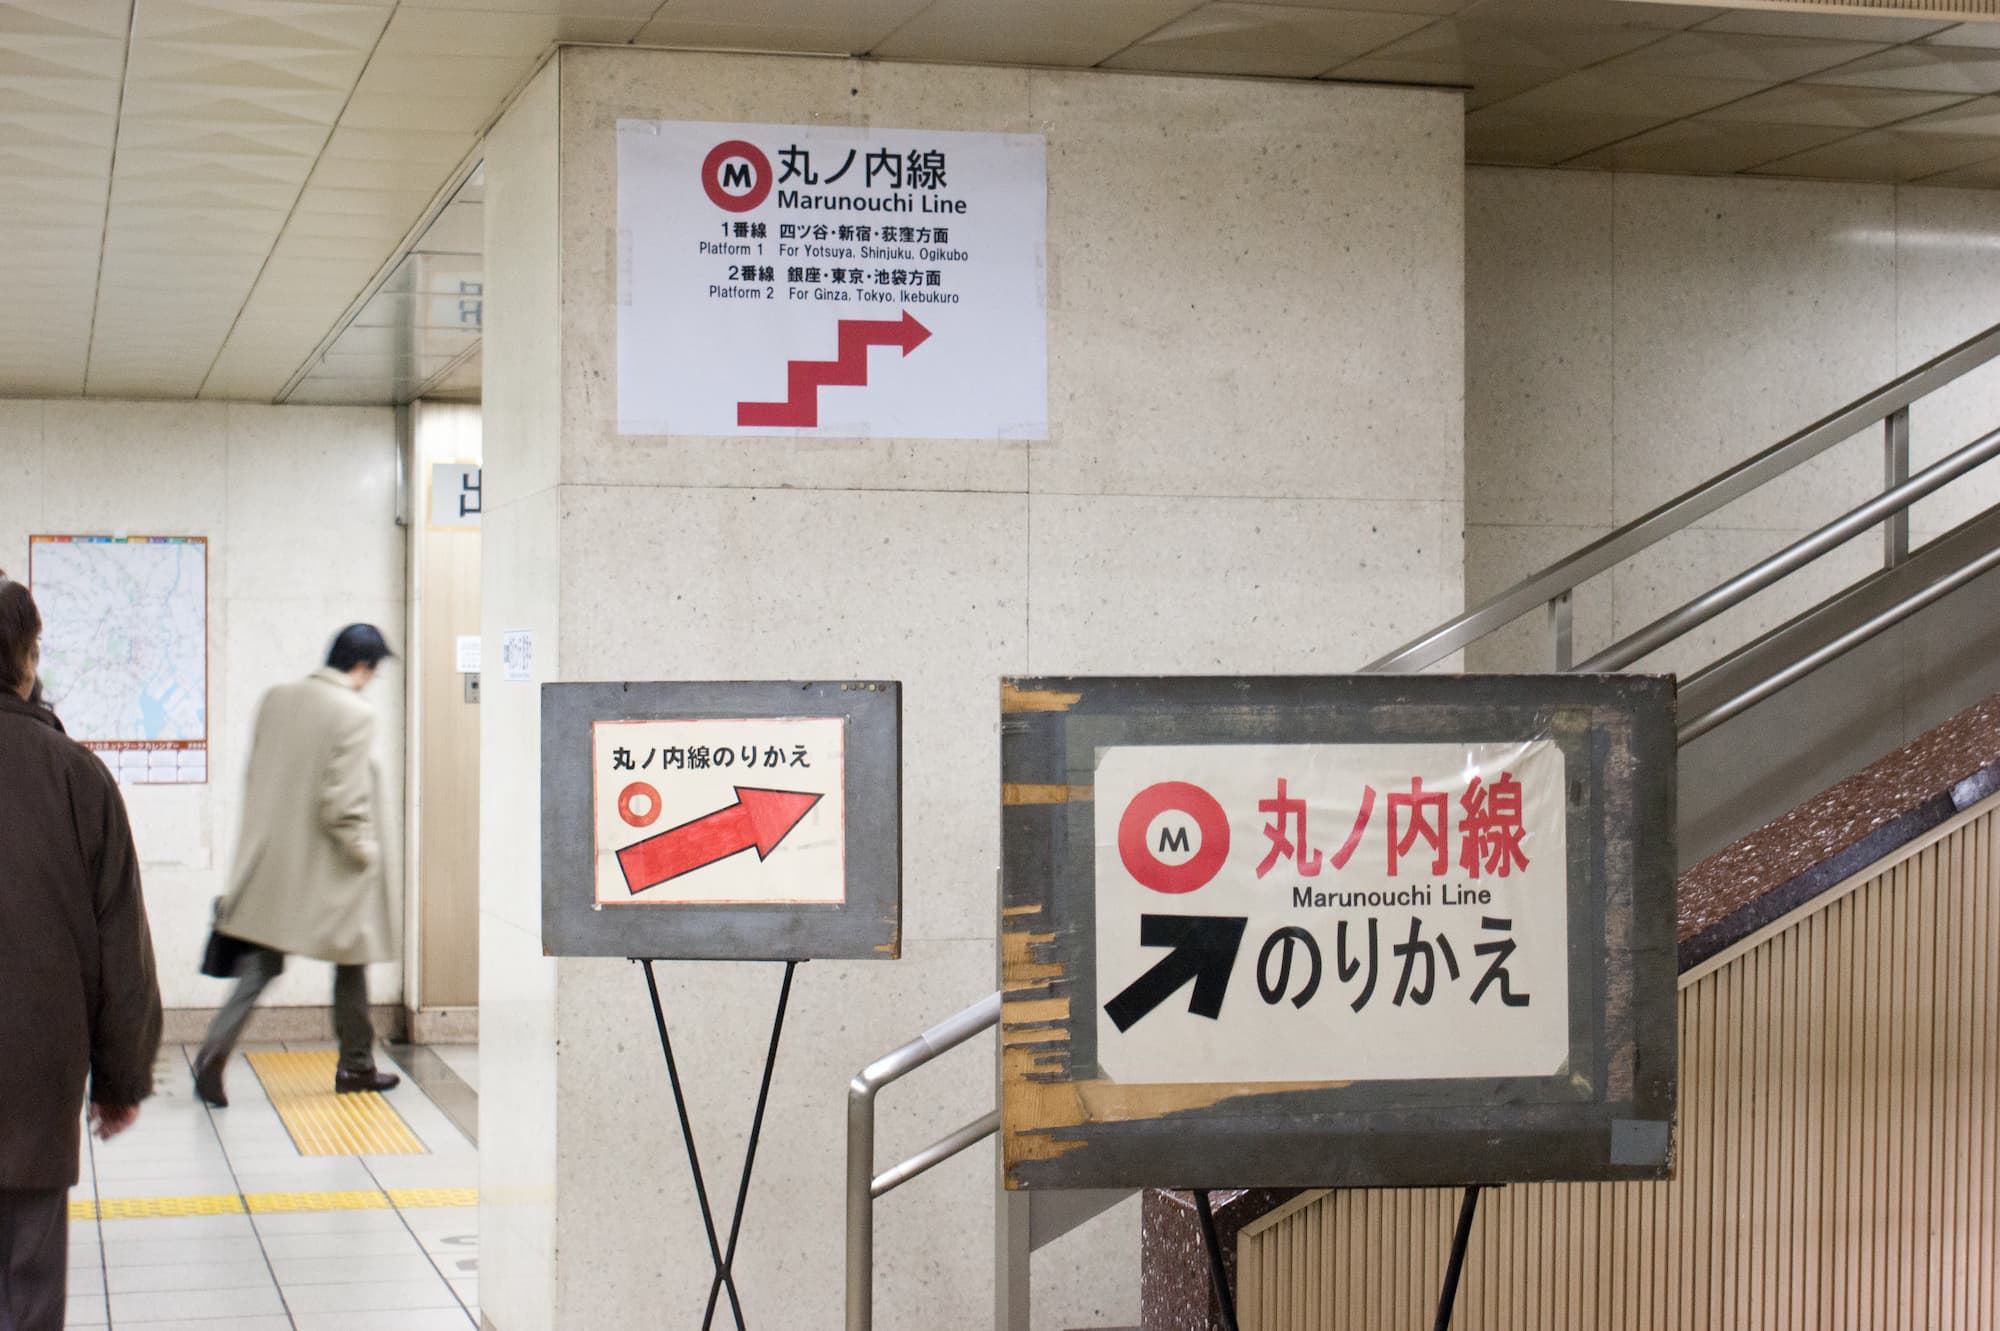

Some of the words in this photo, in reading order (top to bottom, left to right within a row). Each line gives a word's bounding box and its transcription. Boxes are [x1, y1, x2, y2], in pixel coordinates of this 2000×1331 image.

[722, 163, 752, 188] M
[777, 143, 948, 190] 丸ノ内線
[777, 190, 913, 213] Marunouchi
[922, 195, 967, 214] Line
[721, 221, 767, 239] 1番線
[779, 223, 949, 244] 四ツ谷・新宿・荻窪方面
[699, 241, 751, 255] Platform
[757, 243, 763, 256] 1
[779, 243, 800, 256] For
[919, 247, 969, 262] Ogikubo
[728, 265, 775, 282] 2番線
[787, 266, 941, 287] 銀座・東京・池袋方面
[709, 285, 761, 299] Platform
[766, 286, 774, 300] 2
[789, 287, 809, 300] For
[900, 290, 960, 304] Ikebukuro
[612, 744, 811, 771] 丸ノ内線のりかえ
[1255, 771, 1530, 880] 丸ノ内線
[1158, 826, 1190, 853] M
[1292, 884, 1431, 908] Marunouchi
[1441, 883, 1492, 906] Line
[1256, 915, 1530, 1014] のりかえ
